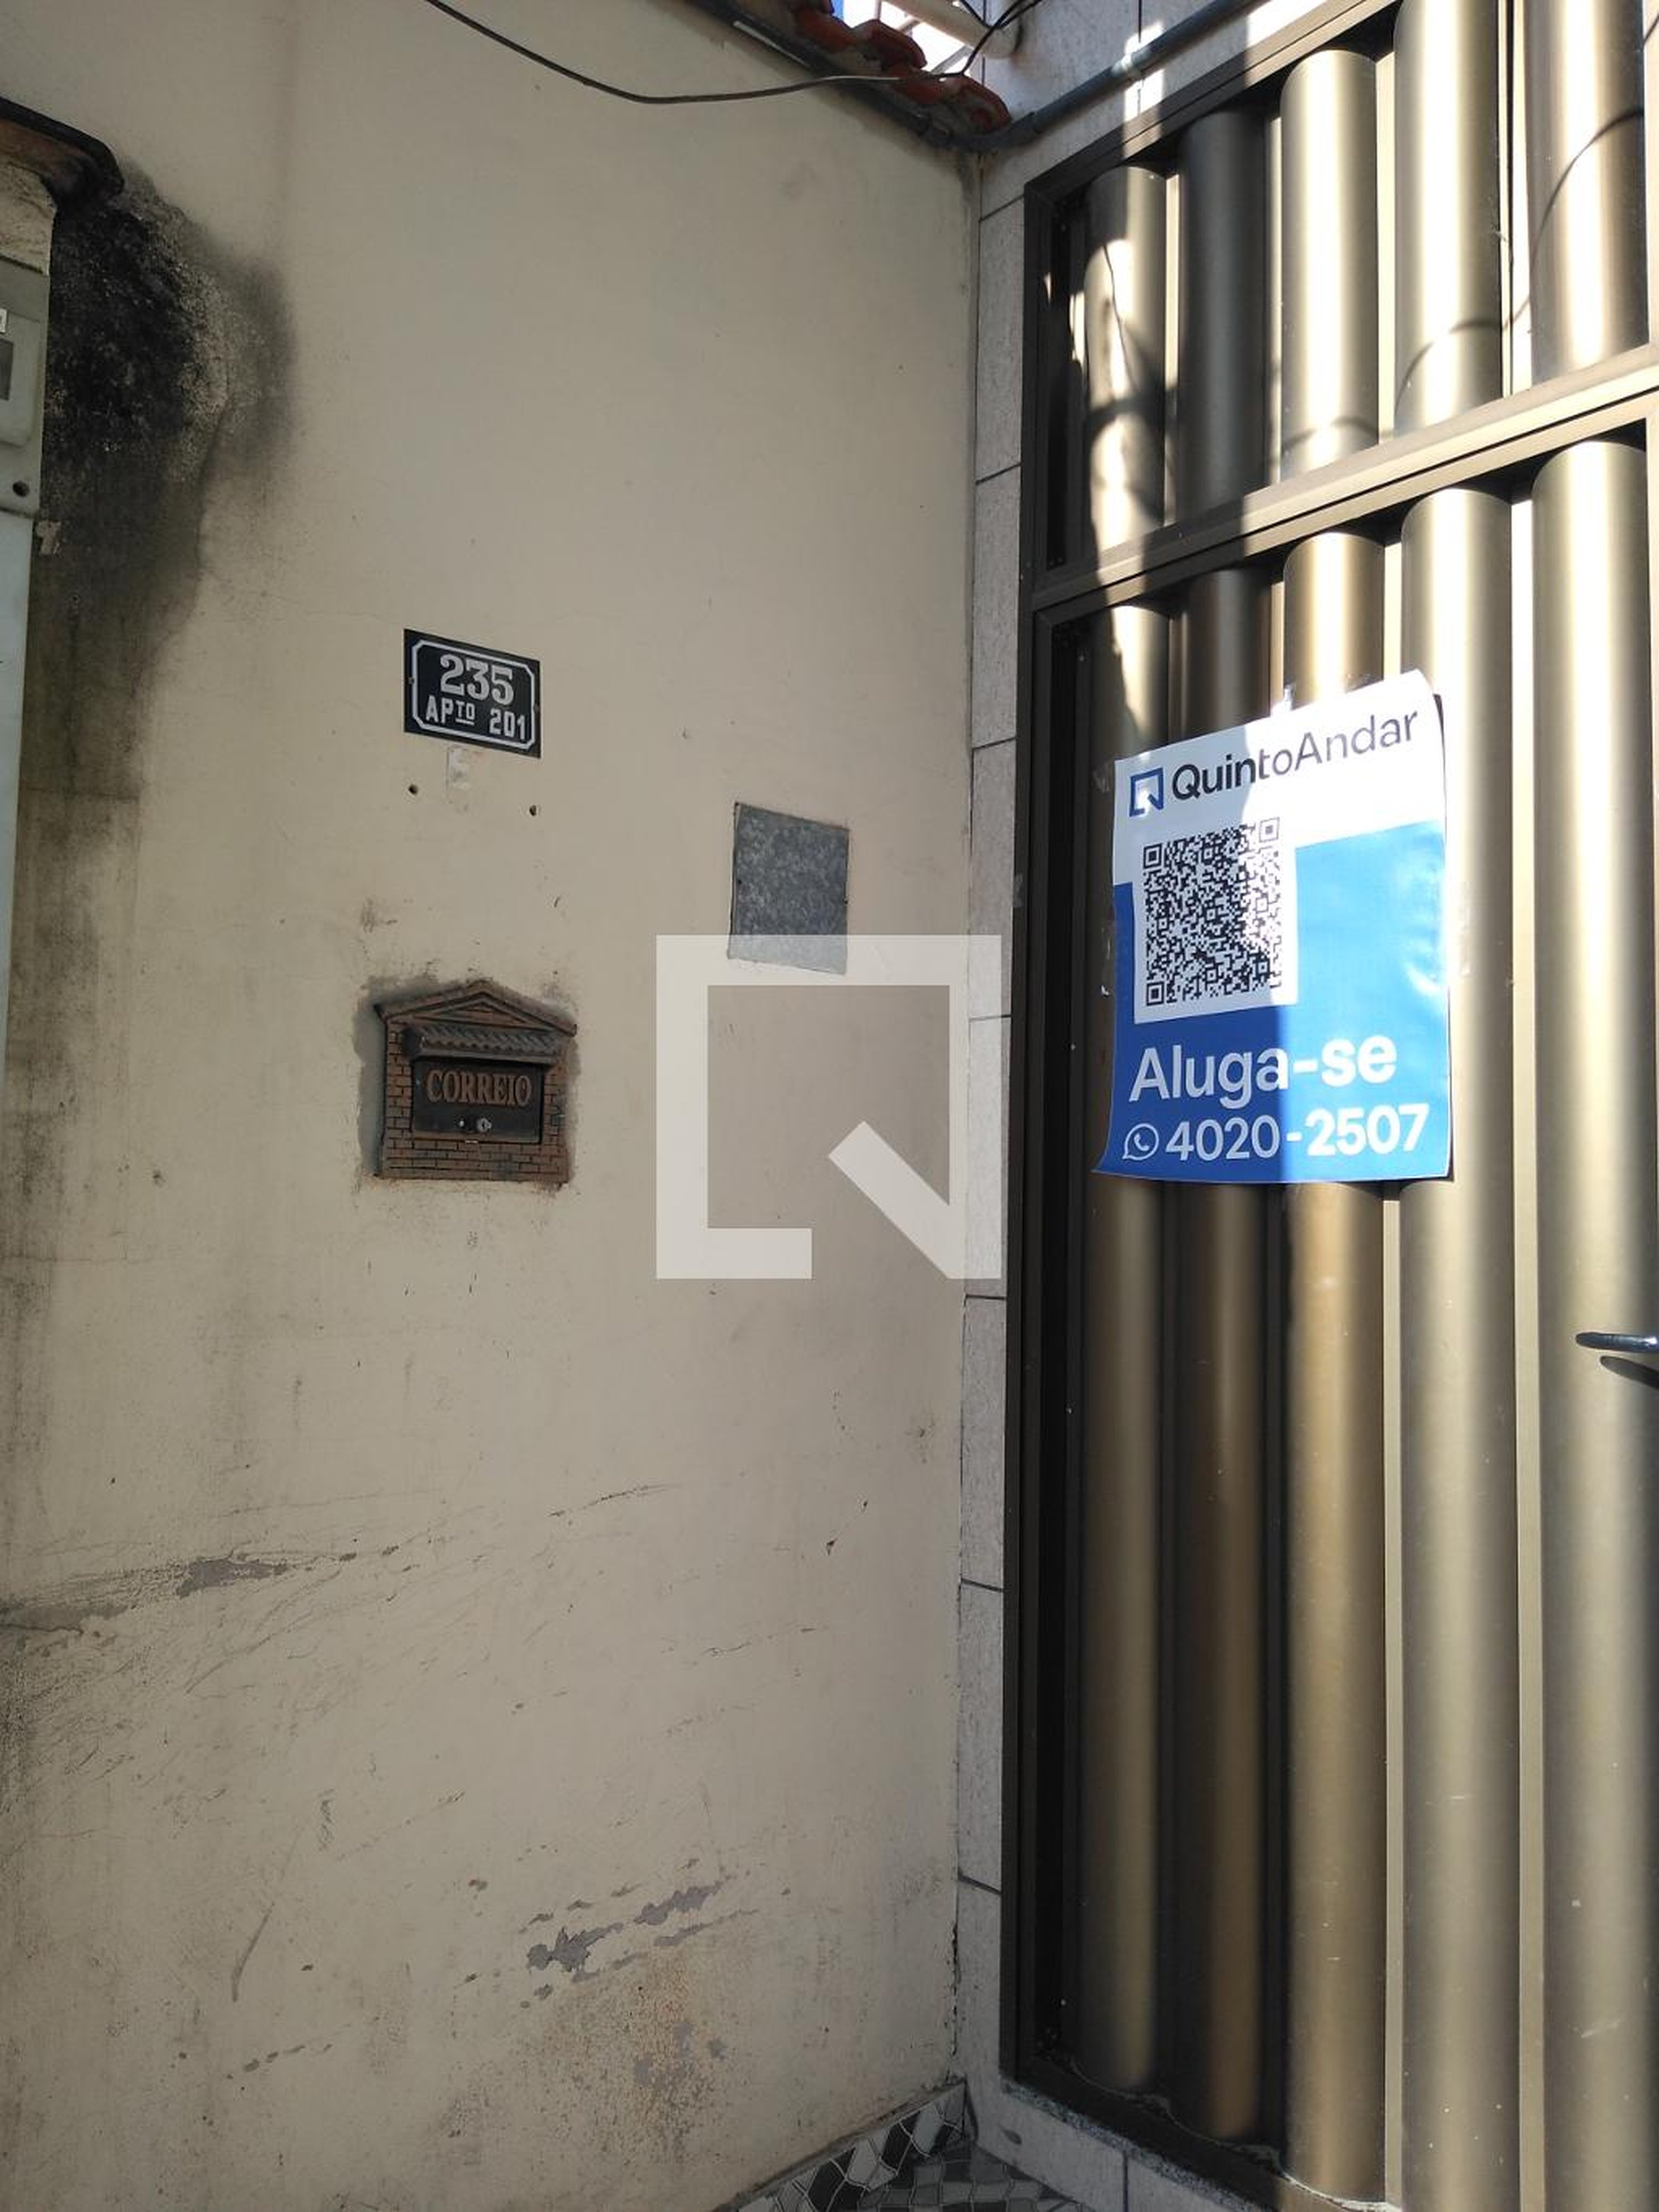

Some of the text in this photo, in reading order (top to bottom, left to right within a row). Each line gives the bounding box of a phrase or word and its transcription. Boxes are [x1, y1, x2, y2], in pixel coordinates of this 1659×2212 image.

[440, 654, 514, 705] 235
[490, 708, 525, 740] 201
[1172, 710, 1418, 801] QuintoAndar
[426, 1070, 532, 1106] CORREIO
[1129, 1035, 1397, 1109] Aluga-se
[1166, 1104, 1430, 1161] 4020-2507
